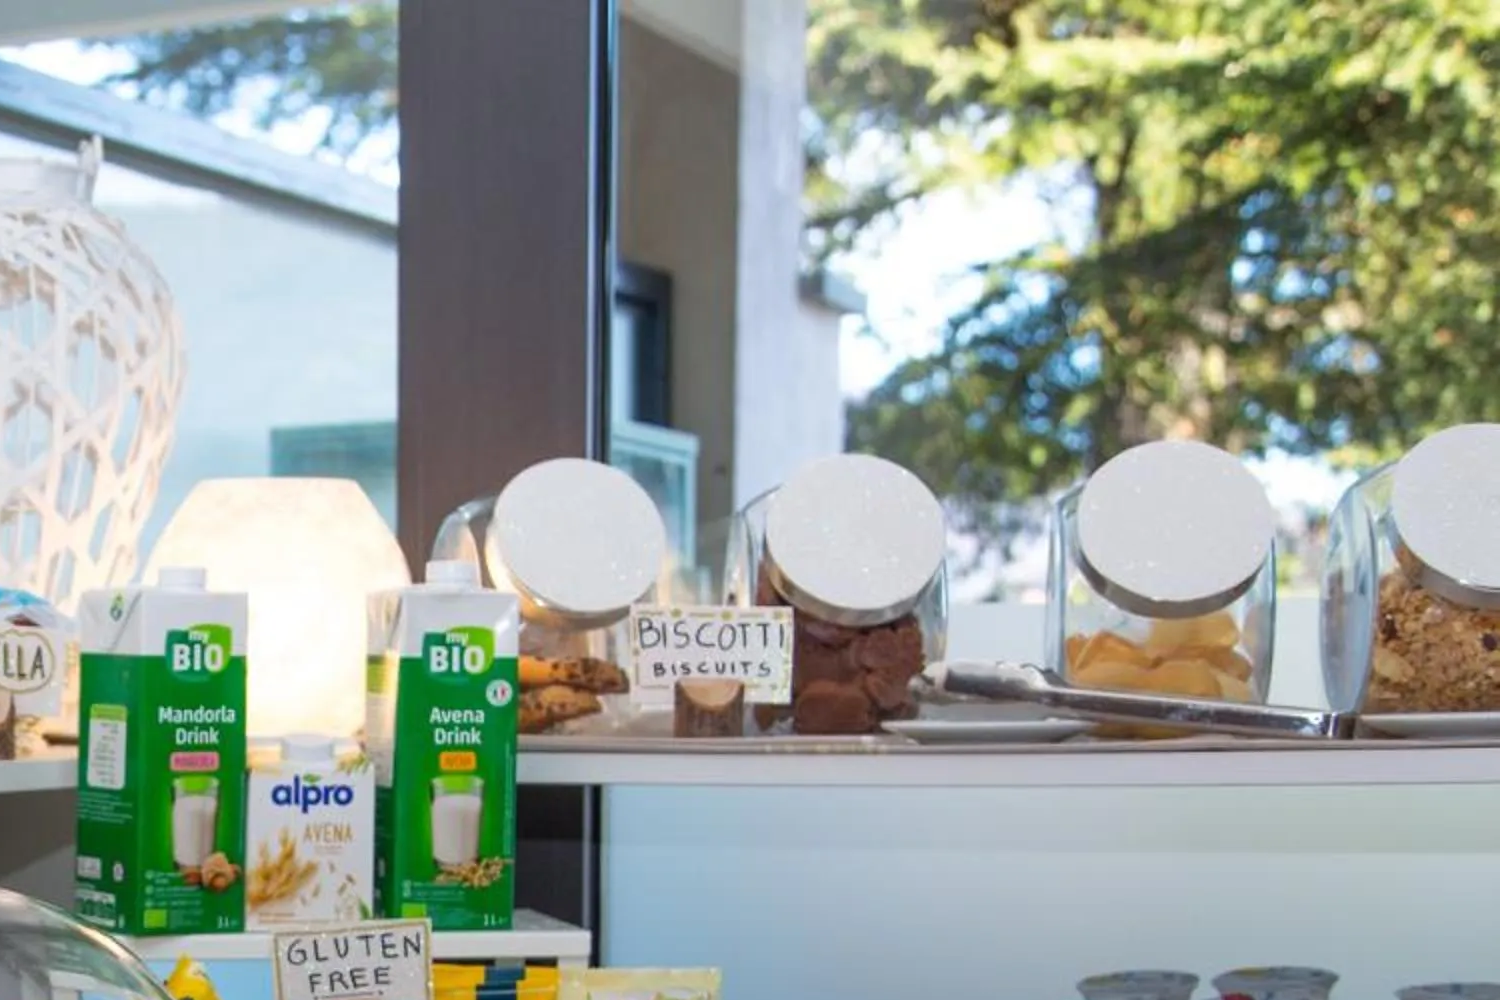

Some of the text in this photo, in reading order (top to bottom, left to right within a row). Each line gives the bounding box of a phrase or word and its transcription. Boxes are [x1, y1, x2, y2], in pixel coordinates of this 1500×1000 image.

[637, 617, 785, 651] BISCOTTI
[173, 644, 224, 673] BIO
[429, 645, 485, 675] BIO
[652, 661, 772, 678] BISCUITS
[158, 706, 237, 724] Mandorla
[429, 707, 485, 725] Avena
[175, 728, 220, 745] Drink
[434, 728, 483, 745] Drink
[271, 774, 354, 814] alpro
[303, 823, 354, 843] AVENA
[286, 932, 423, 966] GLUTEN
[308, 966, 392, 994] FREE
